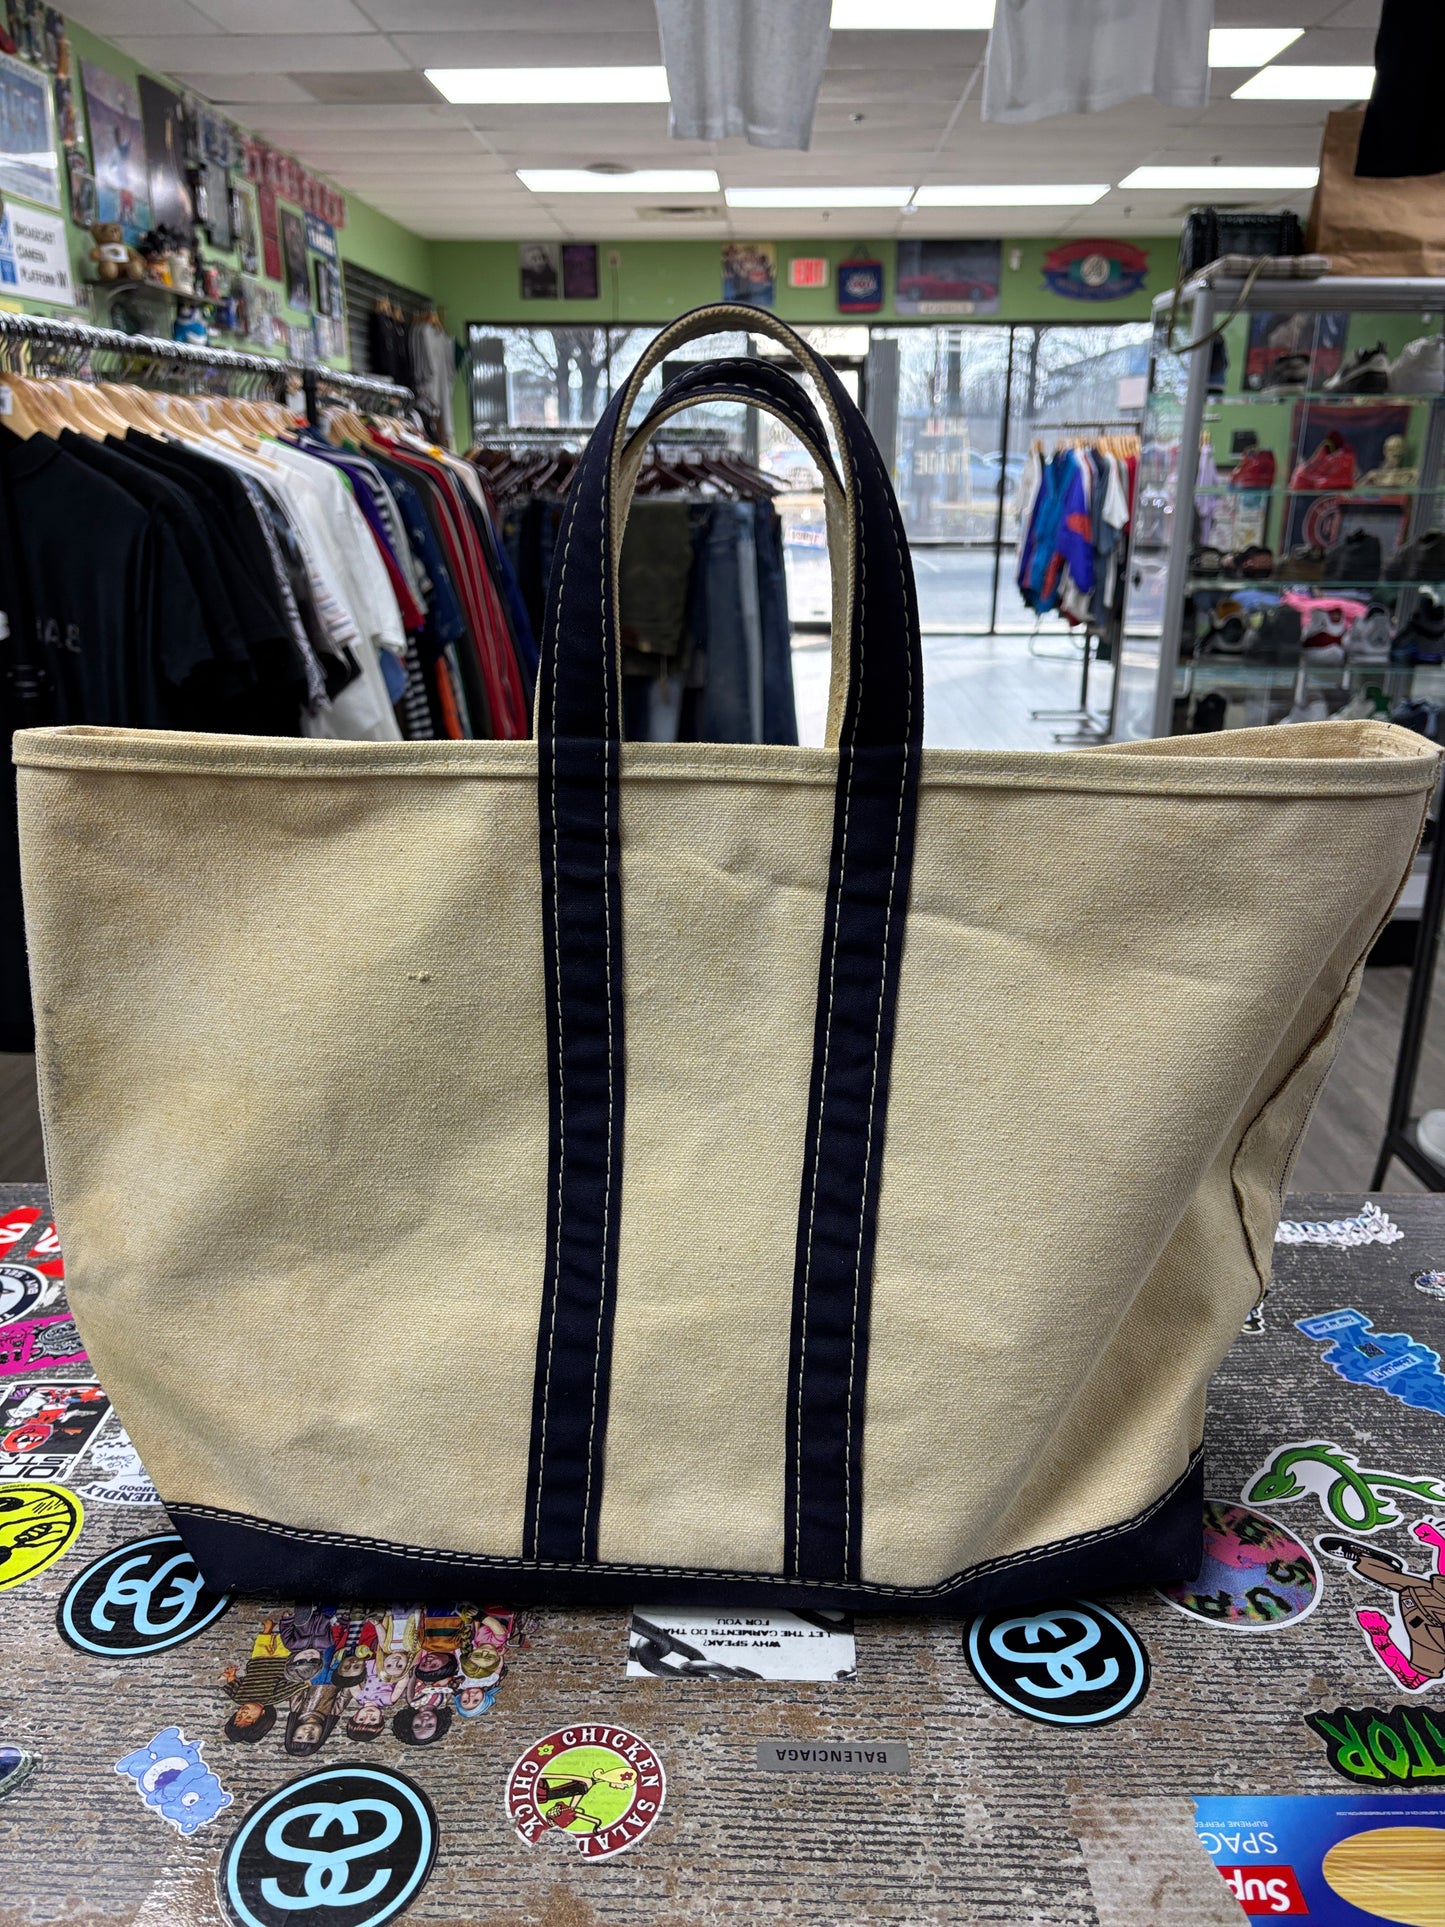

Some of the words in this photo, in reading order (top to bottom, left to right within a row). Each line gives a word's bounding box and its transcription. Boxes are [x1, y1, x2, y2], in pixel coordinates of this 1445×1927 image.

[794, 258, 825, 286] EXIT
[24, 1279, 38, 1295] BUY
[81, 1484, 161, 1502] RIENDLY
[715, 1618, 742, 1626] YOU.
[745, 1618, 770, 1626] FOR
[691, 1628, 708, 1636] DO
[808, 1630, 830, 1638] LET
[702, 1639, 748, 1647] SPEAK?
[751, 1640, 781, 1648] WHY
[562, 1728, 660, 1788] CHICKEN
[775, 1748, 887, 1764] BALENCIAGA
[512, 1760, 542, 1837] CHICK
[576, 1798, 656, 1854] SALAD
[1228, 1820, 1268, 1828] SUPREME
[1198, 1832, 1278, 1854] SPAG
[1224, 1869, 1290, 1912] Sup
